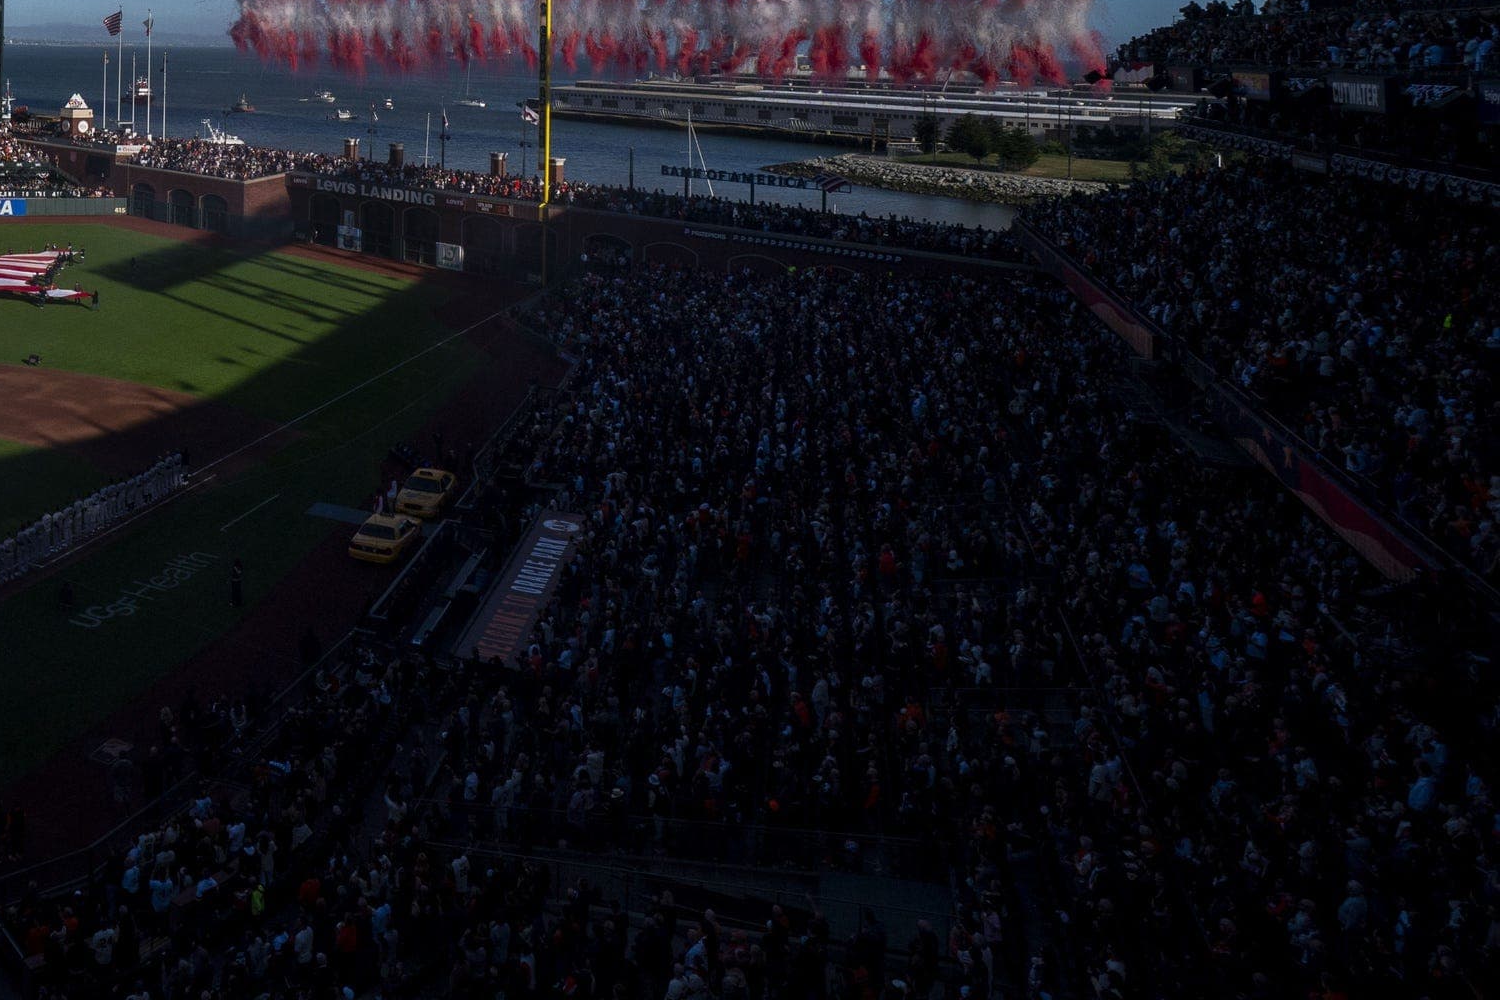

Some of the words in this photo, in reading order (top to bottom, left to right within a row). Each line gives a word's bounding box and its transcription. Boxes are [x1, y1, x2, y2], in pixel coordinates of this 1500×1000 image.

[1332, 82, 1380, 108] CUTWATER
[661, 165, 702, 179] BANK
[707, 169, 727, 181] OF
[731, 171, 807, 190] AMERICA
[361, 185, 436, 206] LANDING
[529, 536, 569, 560] PARK
[120, 552, 221, 600] Health
[510, 559, 557, 594] ORACLE
